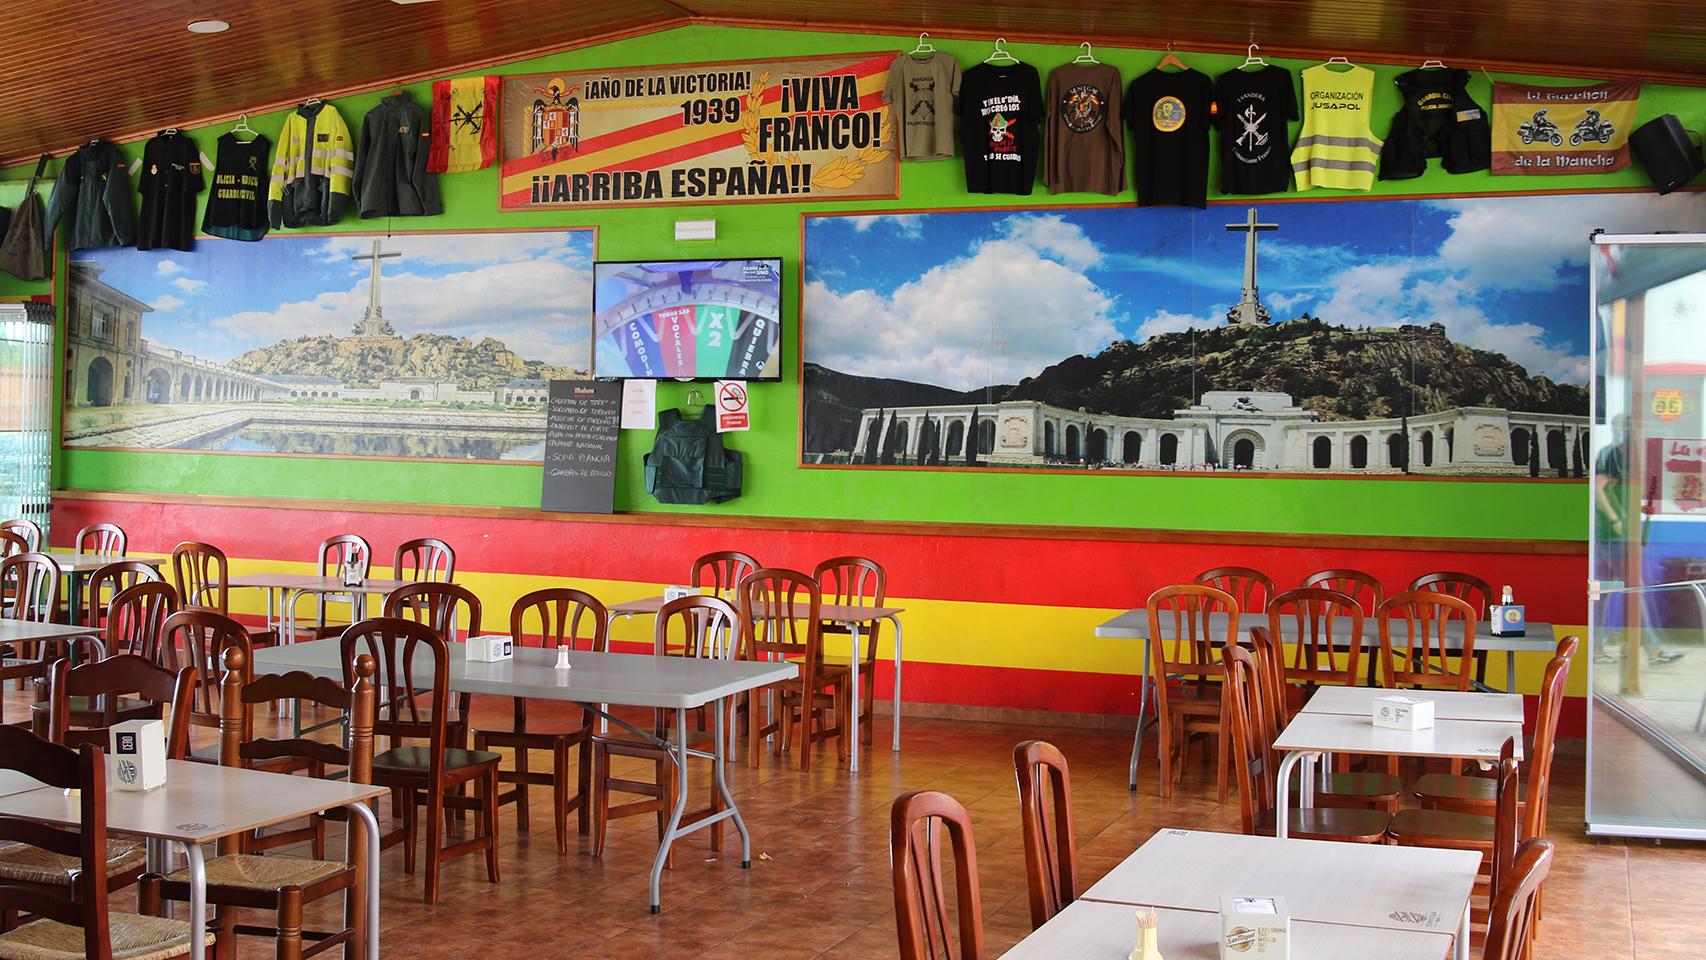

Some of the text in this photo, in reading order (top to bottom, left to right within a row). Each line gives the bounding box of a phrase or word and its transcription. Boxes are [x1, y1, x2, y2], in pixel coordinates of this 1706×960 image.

[585, 71, 751, 100] ¡AÑO DE LA VICTORIA!
[781, 75, 860, 113] ¡VIVA
[681, 97, 740, 125] 1939
[1008, 103, 1020, 112] LOS
[1311, 102, 1361, 110] JUSAPOL
[759, 112, 881, 153] FRANCO!
[1515, 154, 1614, 167] de la Mancha
[531, 160, 812, 203] ¡¡ARRIBA ESPAÑA!!
[671, 316, 684, 367] VOCALES
